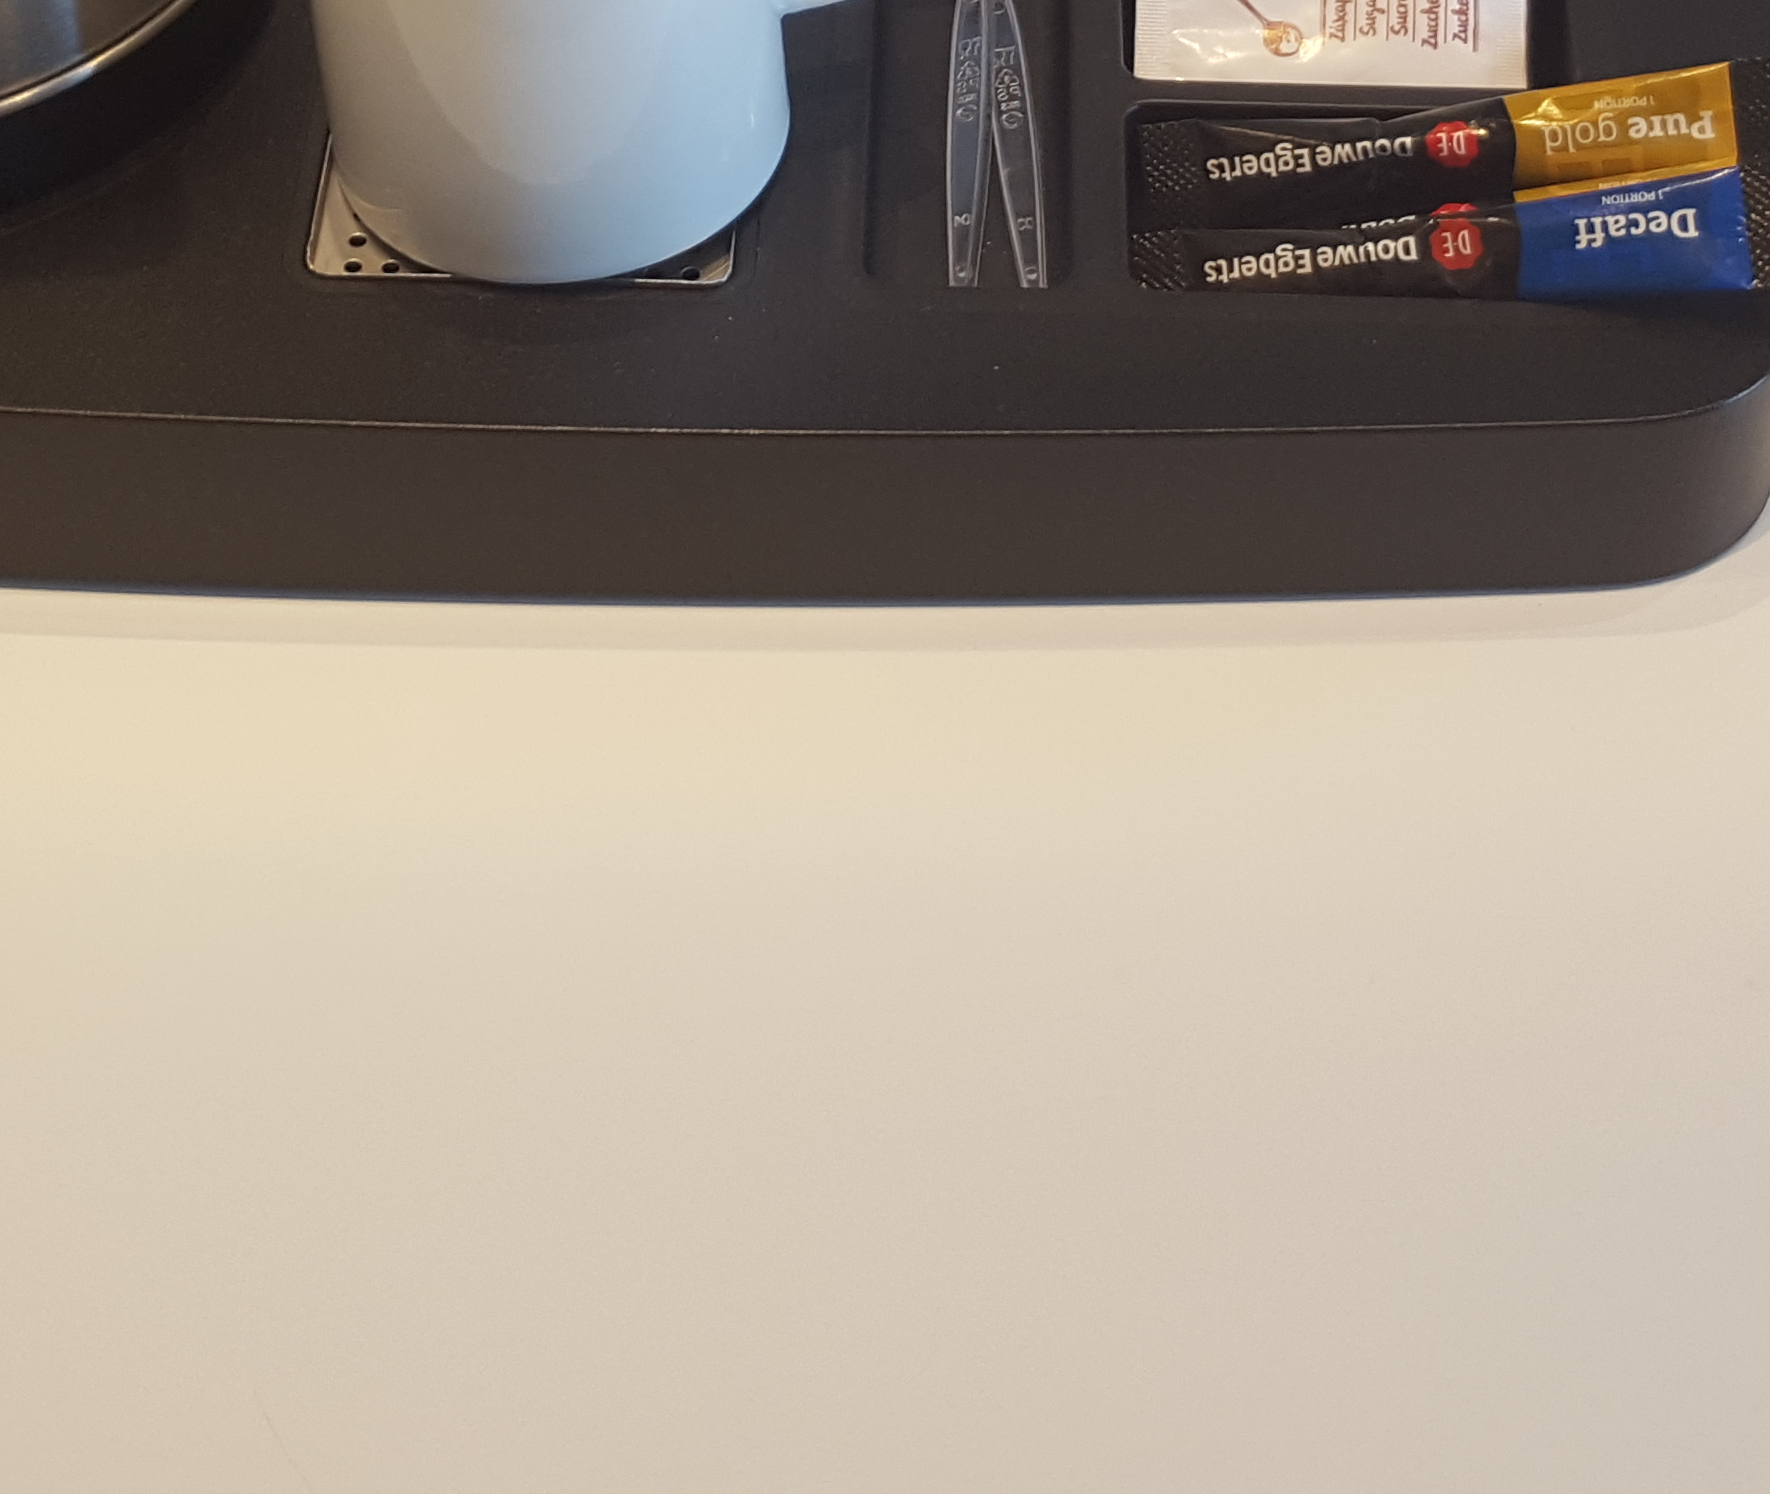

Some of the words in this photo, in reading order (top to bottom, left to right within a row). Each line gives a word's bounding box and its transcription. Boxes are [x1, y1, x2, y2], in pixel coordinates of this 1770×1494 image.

[1593, 95, 1648, 110] PORTION
[1541, 112, 1618, 156] gold
[1627, 110, 1716, 140] Pure
[1206, 142, 1313, 181] Egberts
[1315, 135, 1415, 166] Douwe
[1601, 190, 1657, 206] PORTION
[1573, 208, 1700, 250] Decaff
[1203, 243, 1313, 284] Egberts
[1316, 234, 1419, 268] Douwe
